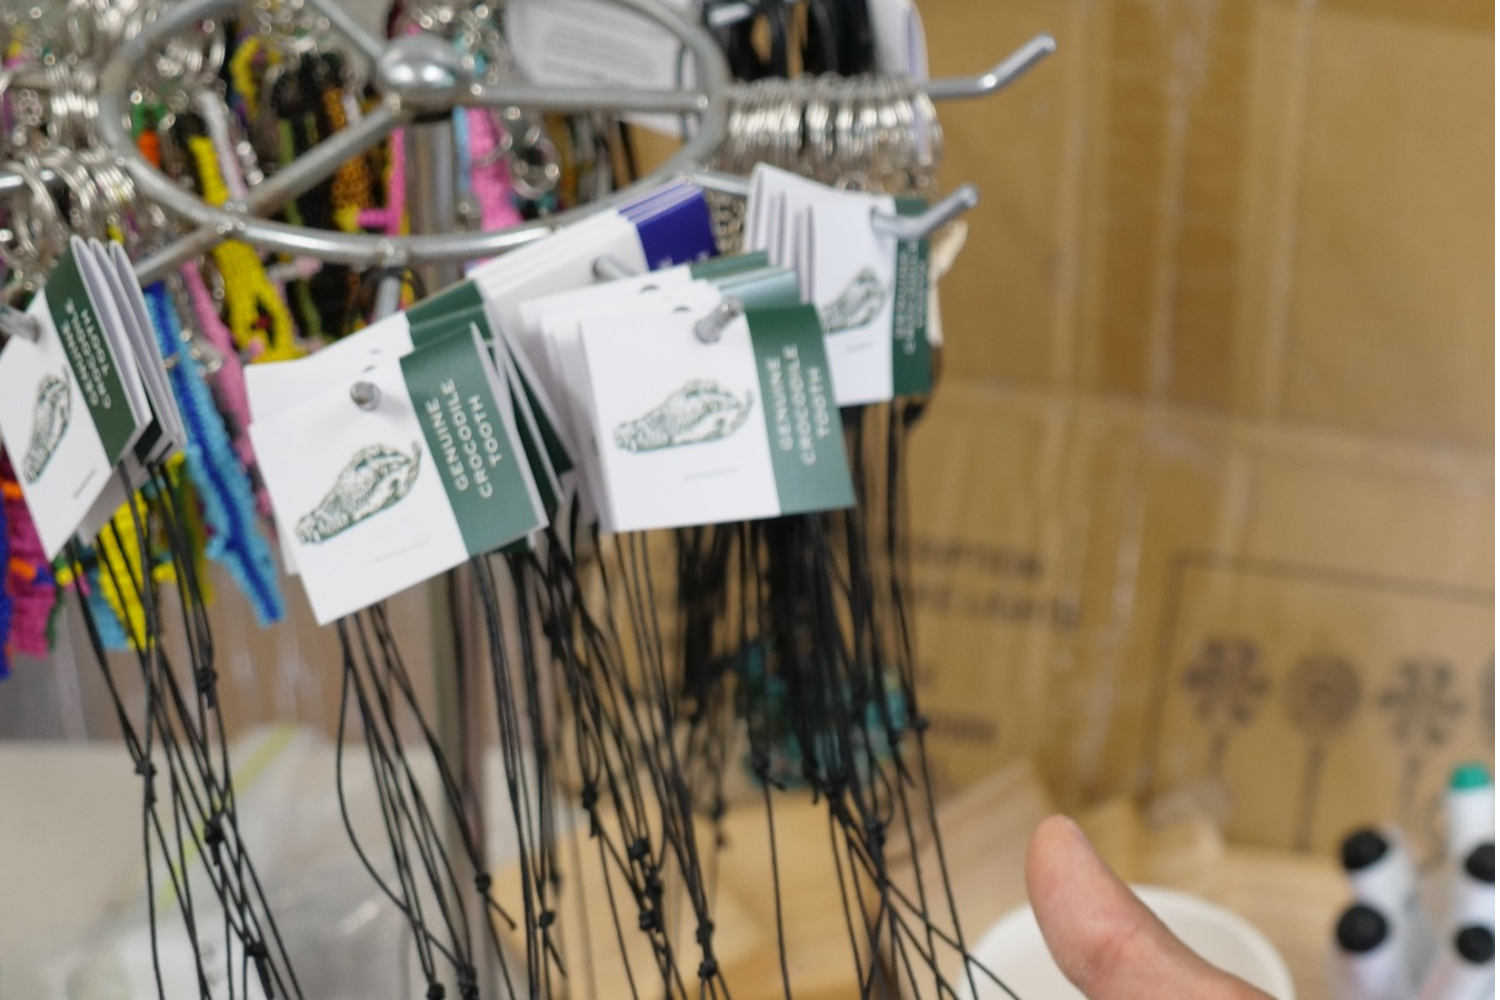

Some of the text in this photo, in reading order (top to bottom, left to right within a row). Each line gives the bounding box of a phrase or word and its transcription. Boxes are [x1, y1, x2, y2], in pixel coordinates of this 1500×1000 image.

[424, 397, 469, 491] GENUINE
[440, 378, 494, 499] CROCODILE
[467, 394, 503, 468] TOOTH
[764, 356, 794, 452] GENUINE
[781, 343, 817, 465] CROCODILE
[808, 366, 831, 438] TOOTH
